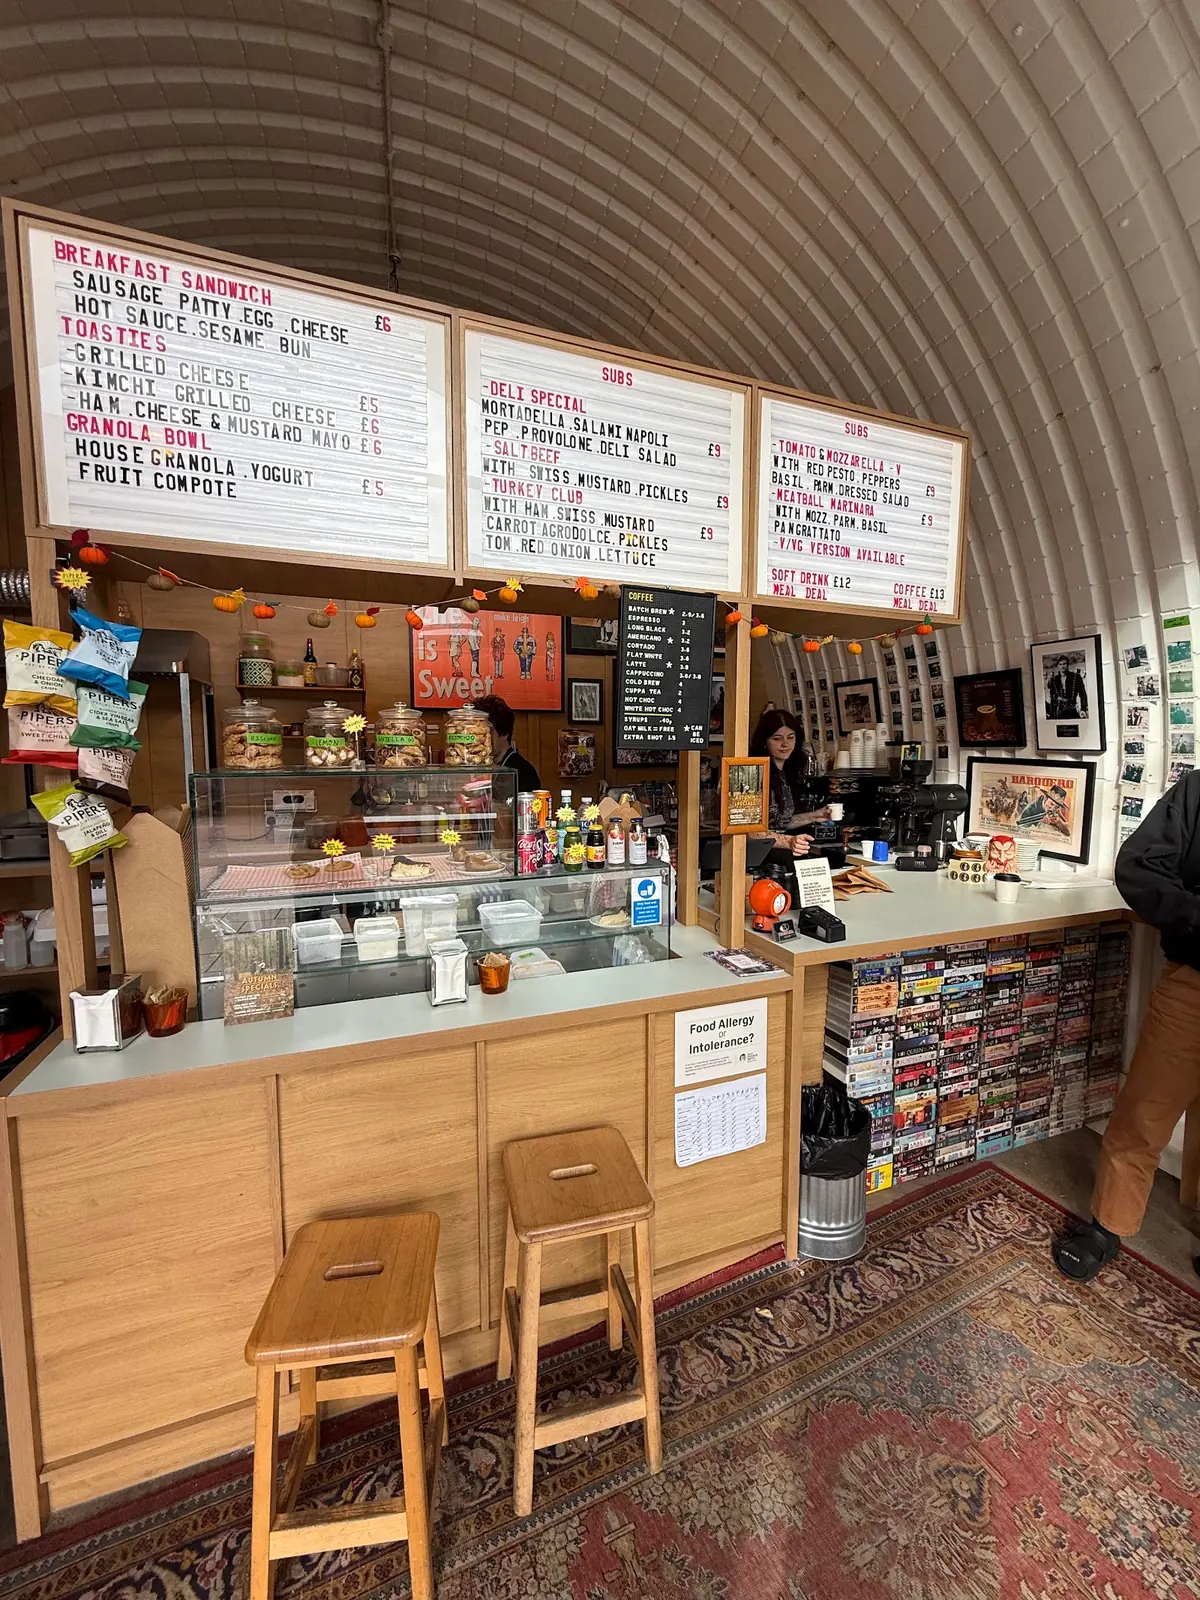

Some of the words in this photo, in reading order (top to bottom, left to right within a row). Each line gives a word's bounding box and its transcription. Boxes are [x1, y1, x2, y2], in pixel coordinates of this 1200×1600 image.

[54, 240, 170, 284] BREAKFAST
[182, 270, 272, 306] SANDWICH
[73, 270, 163, 306] SAUSAGE
[179, 294, 230, 320] PATTY
[374, 315, 392, 333] £6
[61, 316, 167, 352] TOASTIES
[74, 294, 112, 320] HOT
[280, 336, 312, 359] BUN
[179, 362, 249, 391] CHEESE
[360, 396, 379, 413] £5
[602, 367, 633, 387] SUBS
[175, 385, 251, 413] GRILLED
[272, 401, 336, 428] CHEESE
[361, 416, 379, 434] £6
[531, 388, 586, 414] SPECIAL
[66, 413, 151, 442] GRANOLA
[165, 429, 212, 450] BOWL
[211, 413, 221, 430] &
[227, 416, 302, 443] MUSTARD
[312, 430, 350, 450] MAYO
[360, 437, 382, 455] £6
[482, 399, 564, 428] MORTADELLA
[626, 427, 668, 448] NAPOLI
[708, 443, 721, 457] £9
[845, 422, 868, 438] SUBS
[485, 419, 508, 436] PEP
[638, 448, 676, 467] SALAD
[76, 438, 144, 465] HOUSE
[151, 448, 235, 477] GRANOLA
[820, 449, 824, 460] &
[827, 450, 884, 473] MOZZARELLA
[80, 463, 142, 486] FRUIT
[154, 473, 237, 498] COMPOTE
[362, 479, 384, 496] £5
[483, 457, 515, 476] WITH
[529, 464, 569, 484] SWISS
[717, 496, 728, 509] £9
[774, 455, 799, 471] WITH
[807, 462, 824, 476] RED
[926, 485, 935, 497] £9
[552, 487, 583, 504] CLUB
[883, 493, 909, 507] SALAD
[484, 496, 517, 514] WITH
[524, 503, 548, 519] HAM
[700, 527, 713, 540] £9
[776, 505, 800, 520] WITH
[831, 498, 874, 516] MARINARA
[922, 514, 933, 526] £9
[487, 516, 535, 536] CARROT
[774, 520, 840, 541] PANGRATTATO
[486, 534, 510, 551] TOM
[552, 542, 590, 559] ONION
[811, 542, 850, 559] VERSION
[857, 549, 905, 566] AVAILABLE
[772, 568, 795, 583] SOFT
[800, 572, 829, 586] DRINK
[834, 576, 851, 589] £12
[629, 592, 653, 602] COFFEE
[773, 584, 796, 597] MEAL
[806, 587, 827, 600] DEAL
[894, 583, 926, 598] COFFEE
[930, 588, 944, 600] £13
[893, 598, 912, 610] MEAL
[919, 600, 938, 612] DEAL
[513, 614, 529, 624] leigh
[628, 615, 660, 623] ESPRESSO
[418, 633, 438, 661] is
[627, 633, 661, 642] AMERICANO
[627, 642, 655, 650] CORTADO
[21, 652, 64, 667] PIPER
[32, 675, 64, 683] CHEDDAR
[419, 670, 493, 699] Sweet
[89, 692, 137, 710] PIPERS
[21, 711, 74, 725] PIPERS
[110, 713, 134, 723] VINEGAR
[1012, 776, 1074, 788] BARQUERO
[64, 802, 106, 825] PIPERS
[242, 974, 276, 984] AUTUMN
[242, 982, 279, 993] SPECIALS
[690, 1020, 715, 1035] Food
[718, 1015, 754, 1030] Allergy
[719, 1030, 726, 1038] or
[689, 1033, 754, 1054] Intolerance?
